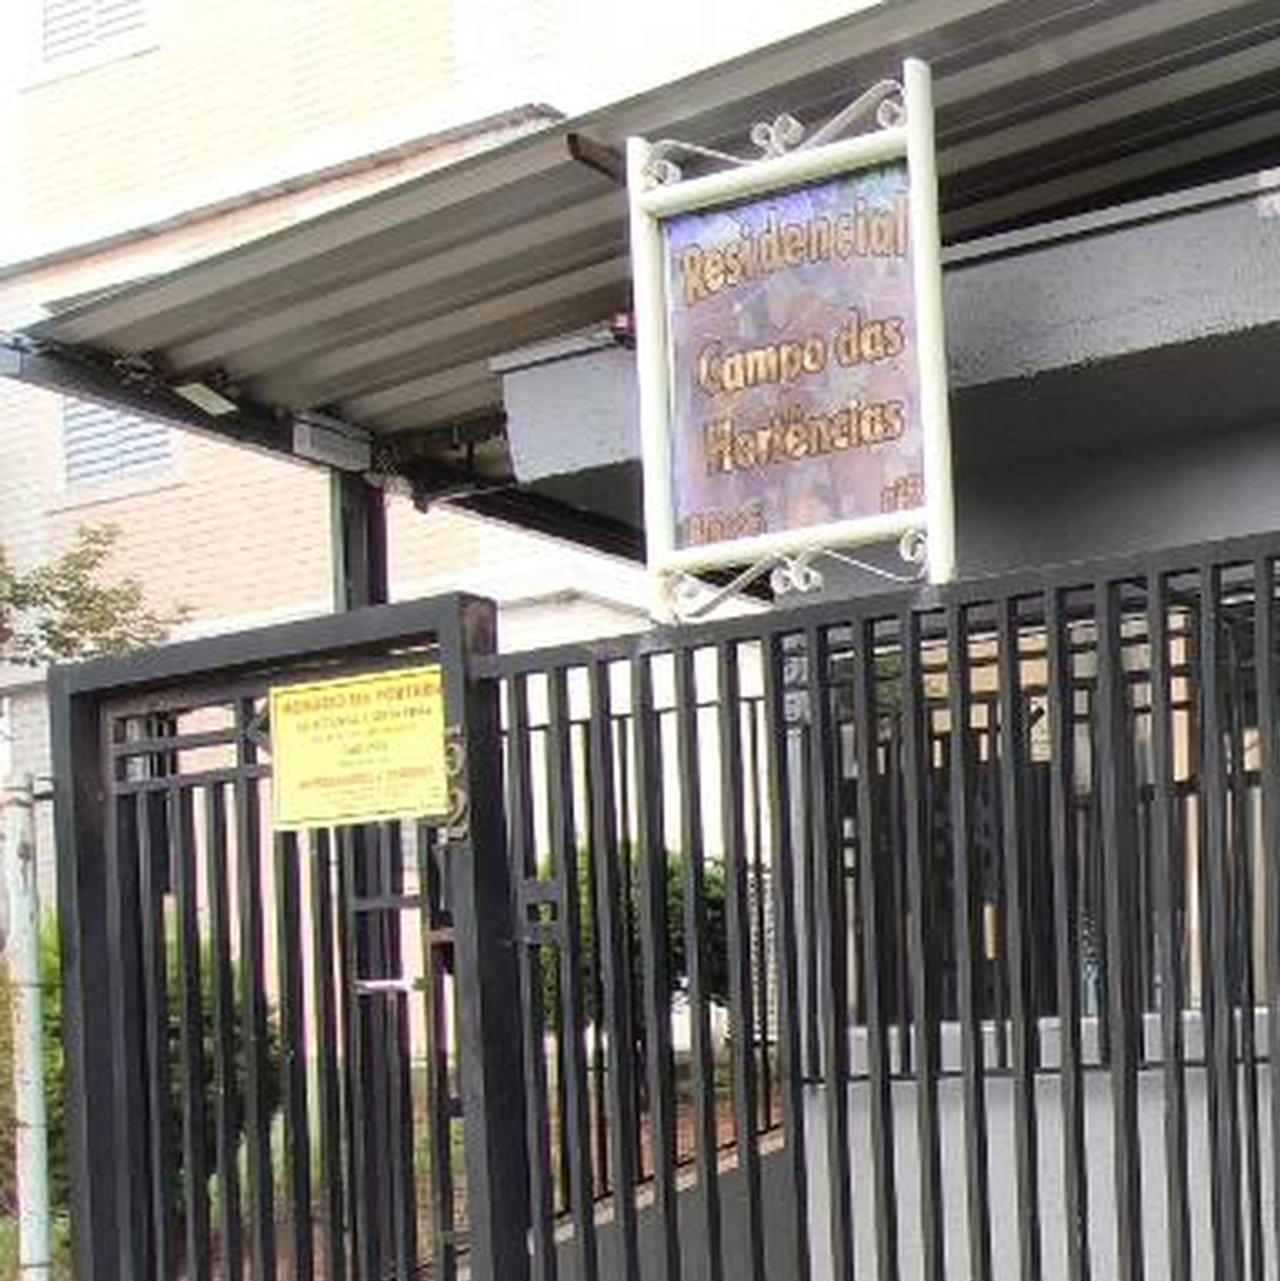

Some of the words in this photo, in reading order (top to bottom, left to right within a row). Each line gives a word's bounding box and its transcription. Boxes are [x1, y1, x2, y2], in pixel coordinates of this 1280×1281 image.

[681, 193, 909, 306] Residencial
[697, 332, 828, 396] Campo
[834, 304, 906, 368] das
